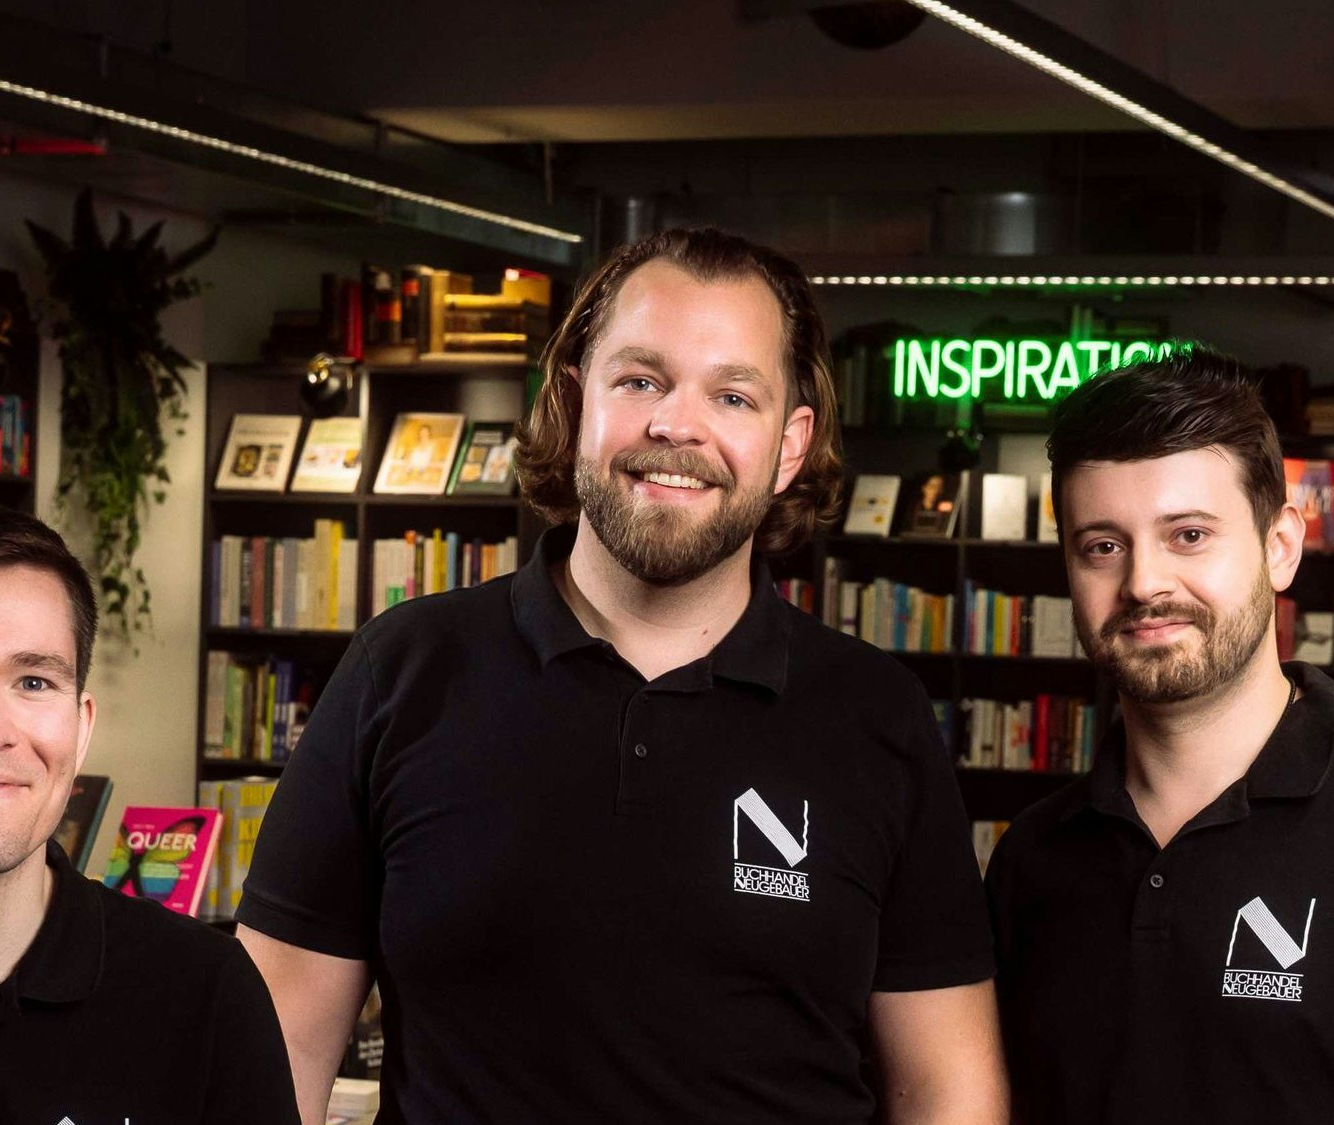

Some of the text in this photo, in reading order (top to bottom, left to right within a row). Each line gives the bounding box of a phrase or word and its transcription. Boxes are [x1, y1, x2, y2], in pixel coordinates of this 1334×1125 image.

[893, 339, 1194, 399] INSPIRAT
[127, 831, 197, 852] QUEER
[733, 866, 809, 888] BUCHHANDEL
[733, 878, 810, 899] NEUGEBAUER
[1222, 983, 1302, 999] NEUGEBAUER
[1223, 972, 1303, 989] BUCHHANDEL
